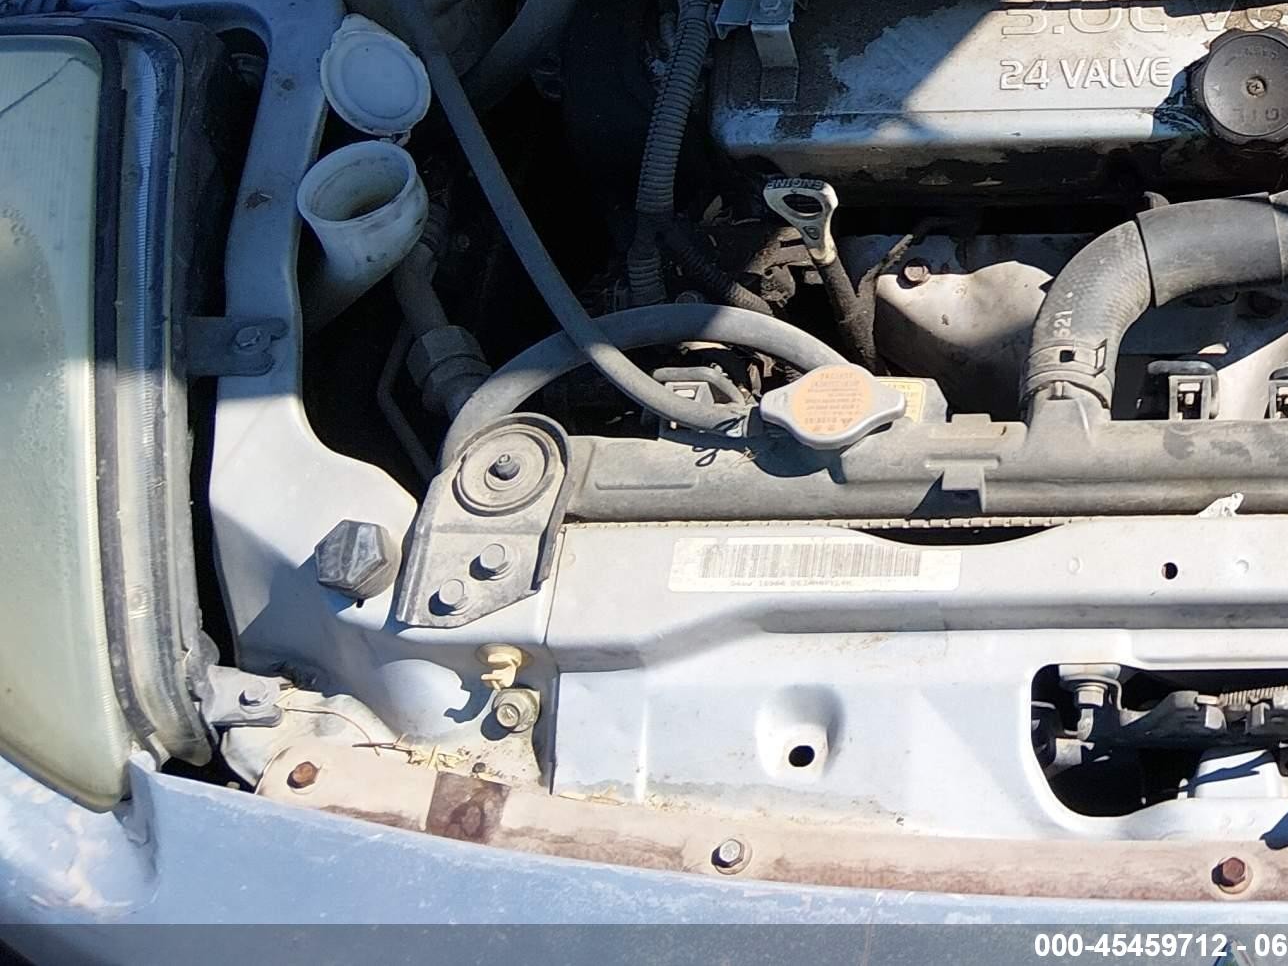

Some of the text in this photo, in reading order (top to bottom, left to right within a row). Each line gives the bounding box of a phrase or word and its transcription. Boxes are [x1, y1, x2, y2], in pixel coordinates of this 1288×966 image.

[1000, 56, 1172, 90] 24 VALVE
[767, 177, 825, 191] ENGINE
